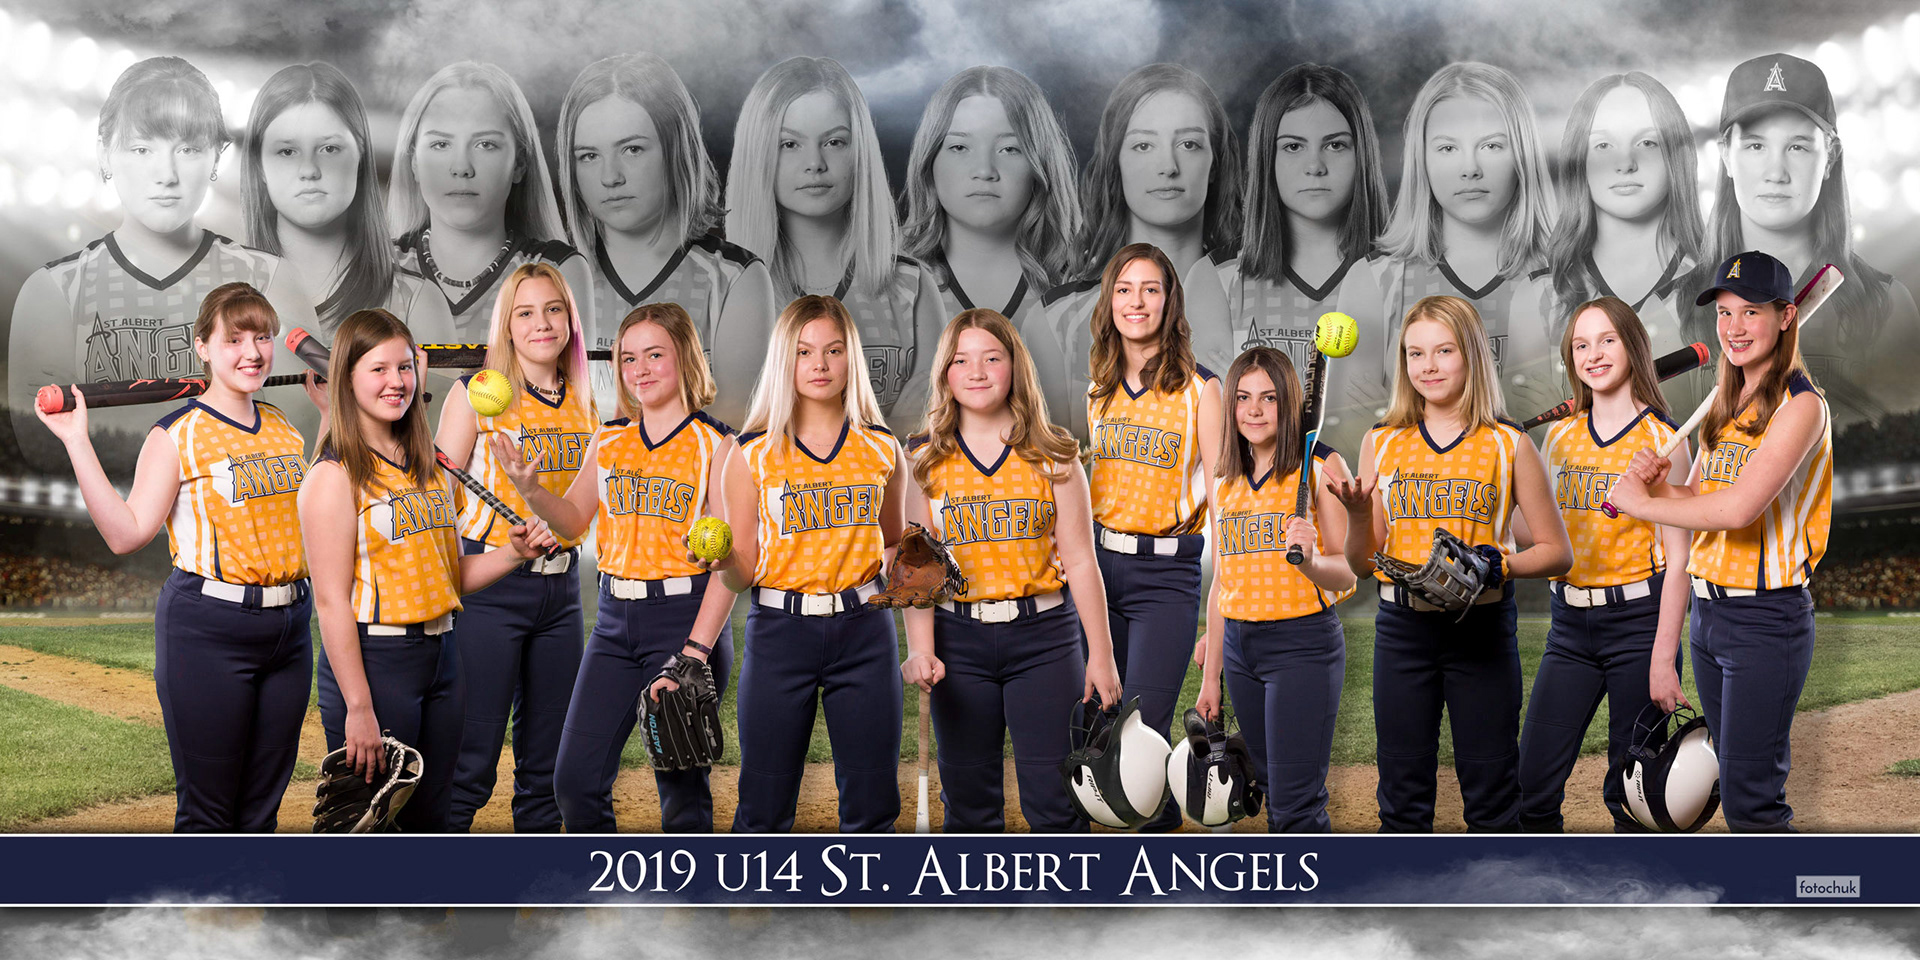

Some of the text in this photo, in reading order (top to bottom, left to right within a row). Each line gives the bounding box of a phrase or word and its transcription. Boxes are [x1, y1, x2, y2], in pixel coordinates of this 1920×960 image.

[121, 318, 165, 327] ALBERT
[1278, 328, 1315, 338] ALBER
[84, 311, 206, 384] ANG
[1093, 417, 1182, 470] ANGELS
[1410, 472, 1440, 480] ALBERT
[1574, 464, 1600, 473] ALBERT
[605, 461, 695, 523] ANGELS
[803, 481, 834, 490] ALBERT
[962, 494, 993, 503] ALBERT
[1388, 466, 1497, 525] ANGELS
[780, 478, 884, 535] ANGEL
[940, 490, 1055, 546] ANGELS
